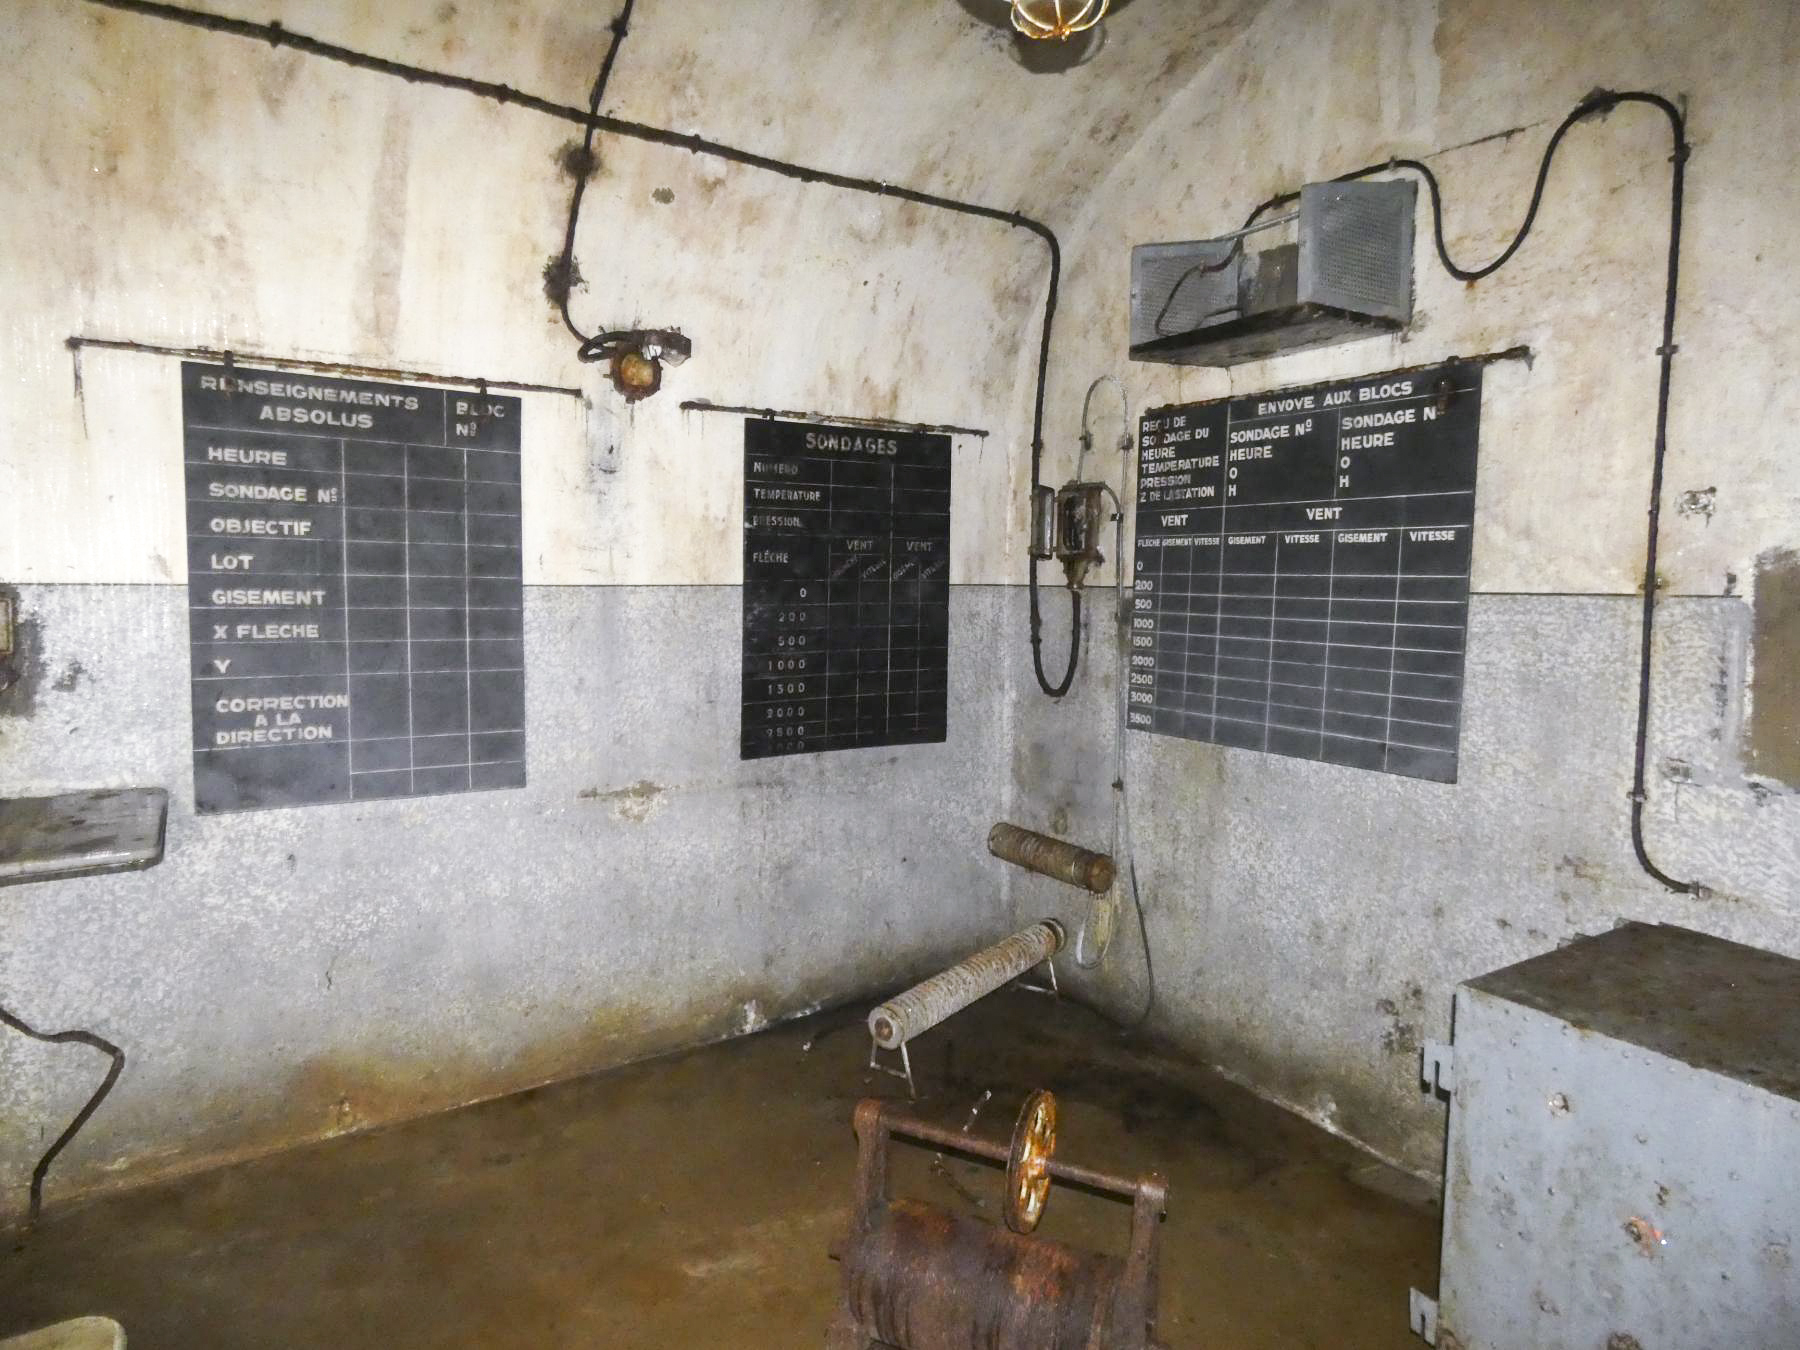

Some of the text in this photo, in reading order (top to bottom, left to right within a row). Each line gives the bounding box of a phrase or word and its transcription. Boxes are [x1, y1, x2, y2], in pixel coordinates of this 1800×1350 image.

[1323, 390, 1352, 407] AUX
[1359, 381, 1413, 401] BLOCS
[259, 405, 374, 429] ABSOLUS
[1173, 415, 1187, 428] DE
[1341, 405, 1446, 430] SONDAGE N
[1142, 427, 1210, 447] SODAGE DU
[1230, 426, 1290, 444] SONDAGE
[1341, 432, 1395, 451] HEURE
[805, 431, 897, 455] SONDAGES
[208, 447, 287, 466] HEURE
[1142, 446, 1176, 461] HEURE
[1229, 446, 1273, 462] HEURE
[1141, 455, 1220, 474] TEMPERATURE
[1140, 474, 1191, 489] PRESSION
[1339, 475, 1350, 488] H
[208, 482, 307, 503] SONDAGE
[1228, 484, 1237, 497] H
[1161, 514, 1189, 527] VENT
[1306, 507, 1343, 521] VENT
[210, 517, 312, 536] OBJECTIF
[1194, 537, 1220, 546] VITESSE
[1227, 535, 1266, 545] GISEMENT
[1284, 534, 1320, 544] VITESSE
[1337, 532, 1389, 544] GISEMENT
[1409, 530, 1456, 542] VITESSE
[846, 539, 873, 551] VENT
[211, 553, 254, 570] LOT
[1134, 580, 1153, 592] 200
[212, 589, 326, 607] GISEMENT
[1134, 599, 1152, 609] 500
[1133, 618, 1153, 628] 1000
[213, 624, 319, 640] X FLECHE
[1132, 637, 1153, 647] 1500
[213, 659, 231, 674] Y
[767, 659, 806, 672] 1000
[1132, 655, 1154, 667] 2000
[1131, 673, 1153, 685] 2500
[216, 694, 349, 714] CORRECTION
[1130, 692, 1153, 704] 3000
[255, 712, 302, 727] A LA
[216, 726, 333, 746] DIRECTION
